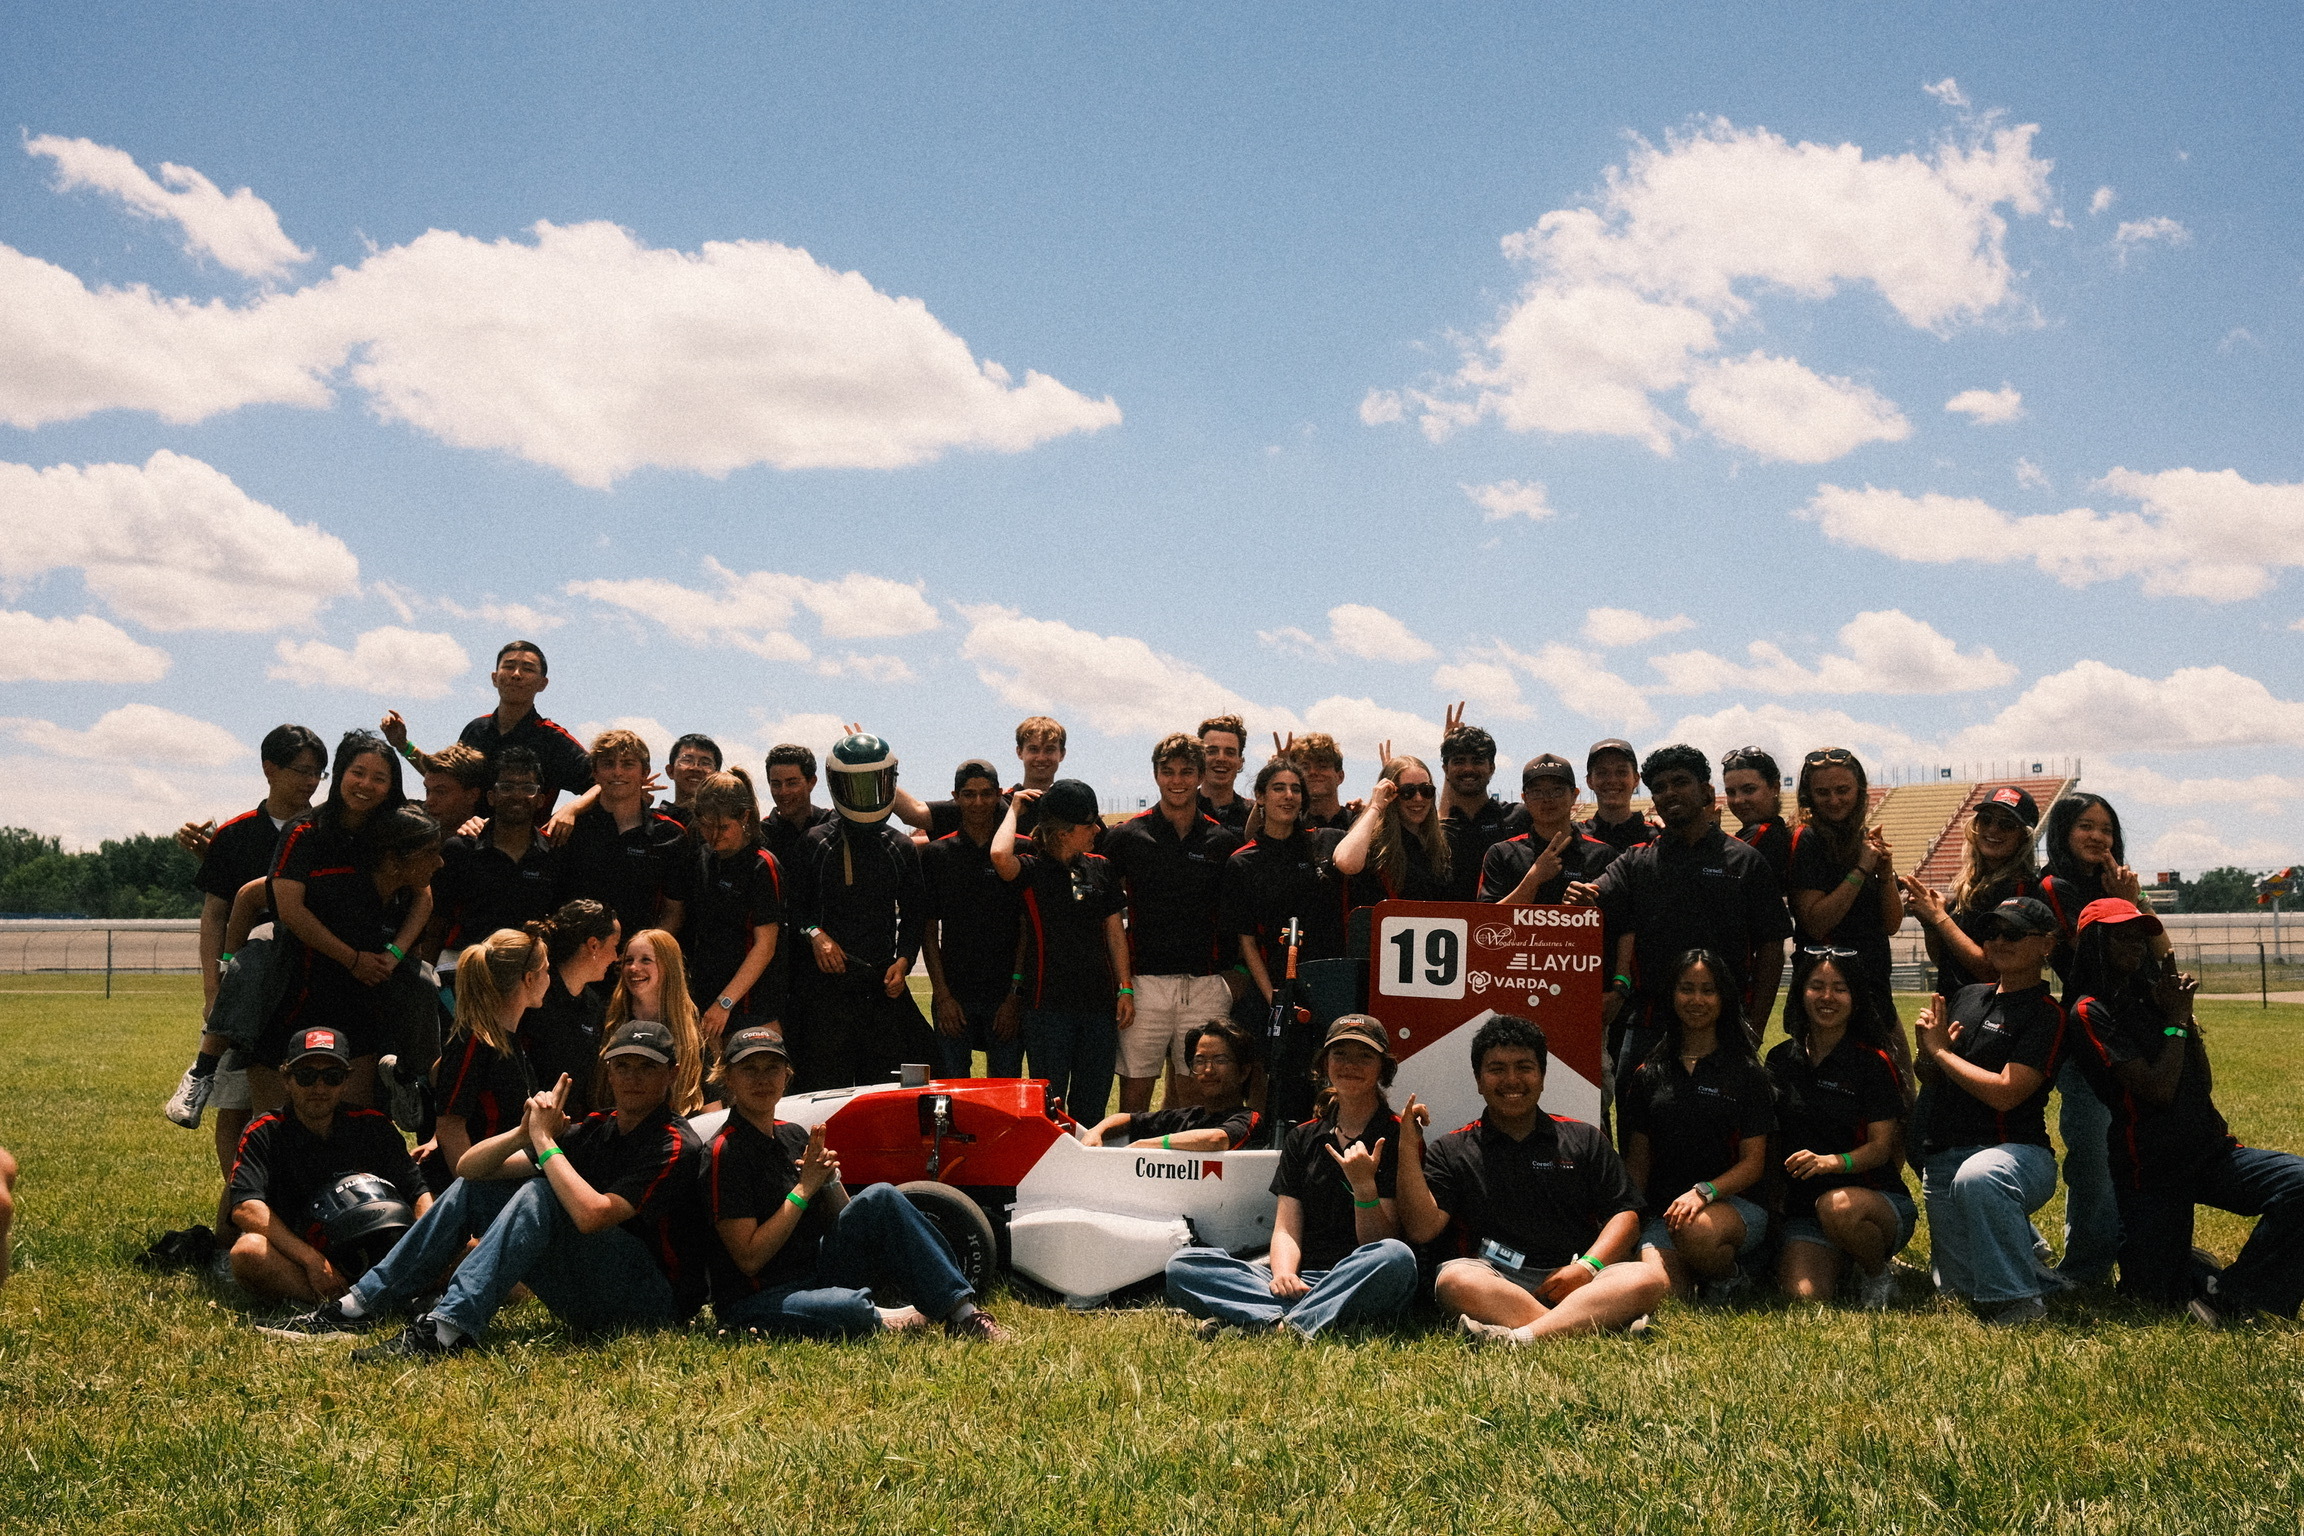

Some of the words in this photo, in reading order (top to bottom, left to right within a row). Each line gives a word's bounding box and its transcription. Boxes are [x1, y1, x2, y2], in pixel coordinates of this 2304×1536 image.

[1513, 908, 1600, 928] KISSsoft
[1476, 927, 1528, 947] Woodward
[1529, 933, 1562, 947] Industries
[1390, 928, 1459, 987] 19
[1531, 953, 1602, 972] LAYUP
[1493, 976, 1549, 990] VARDA
[1135, 1156, 1199, 1181] Cornell
